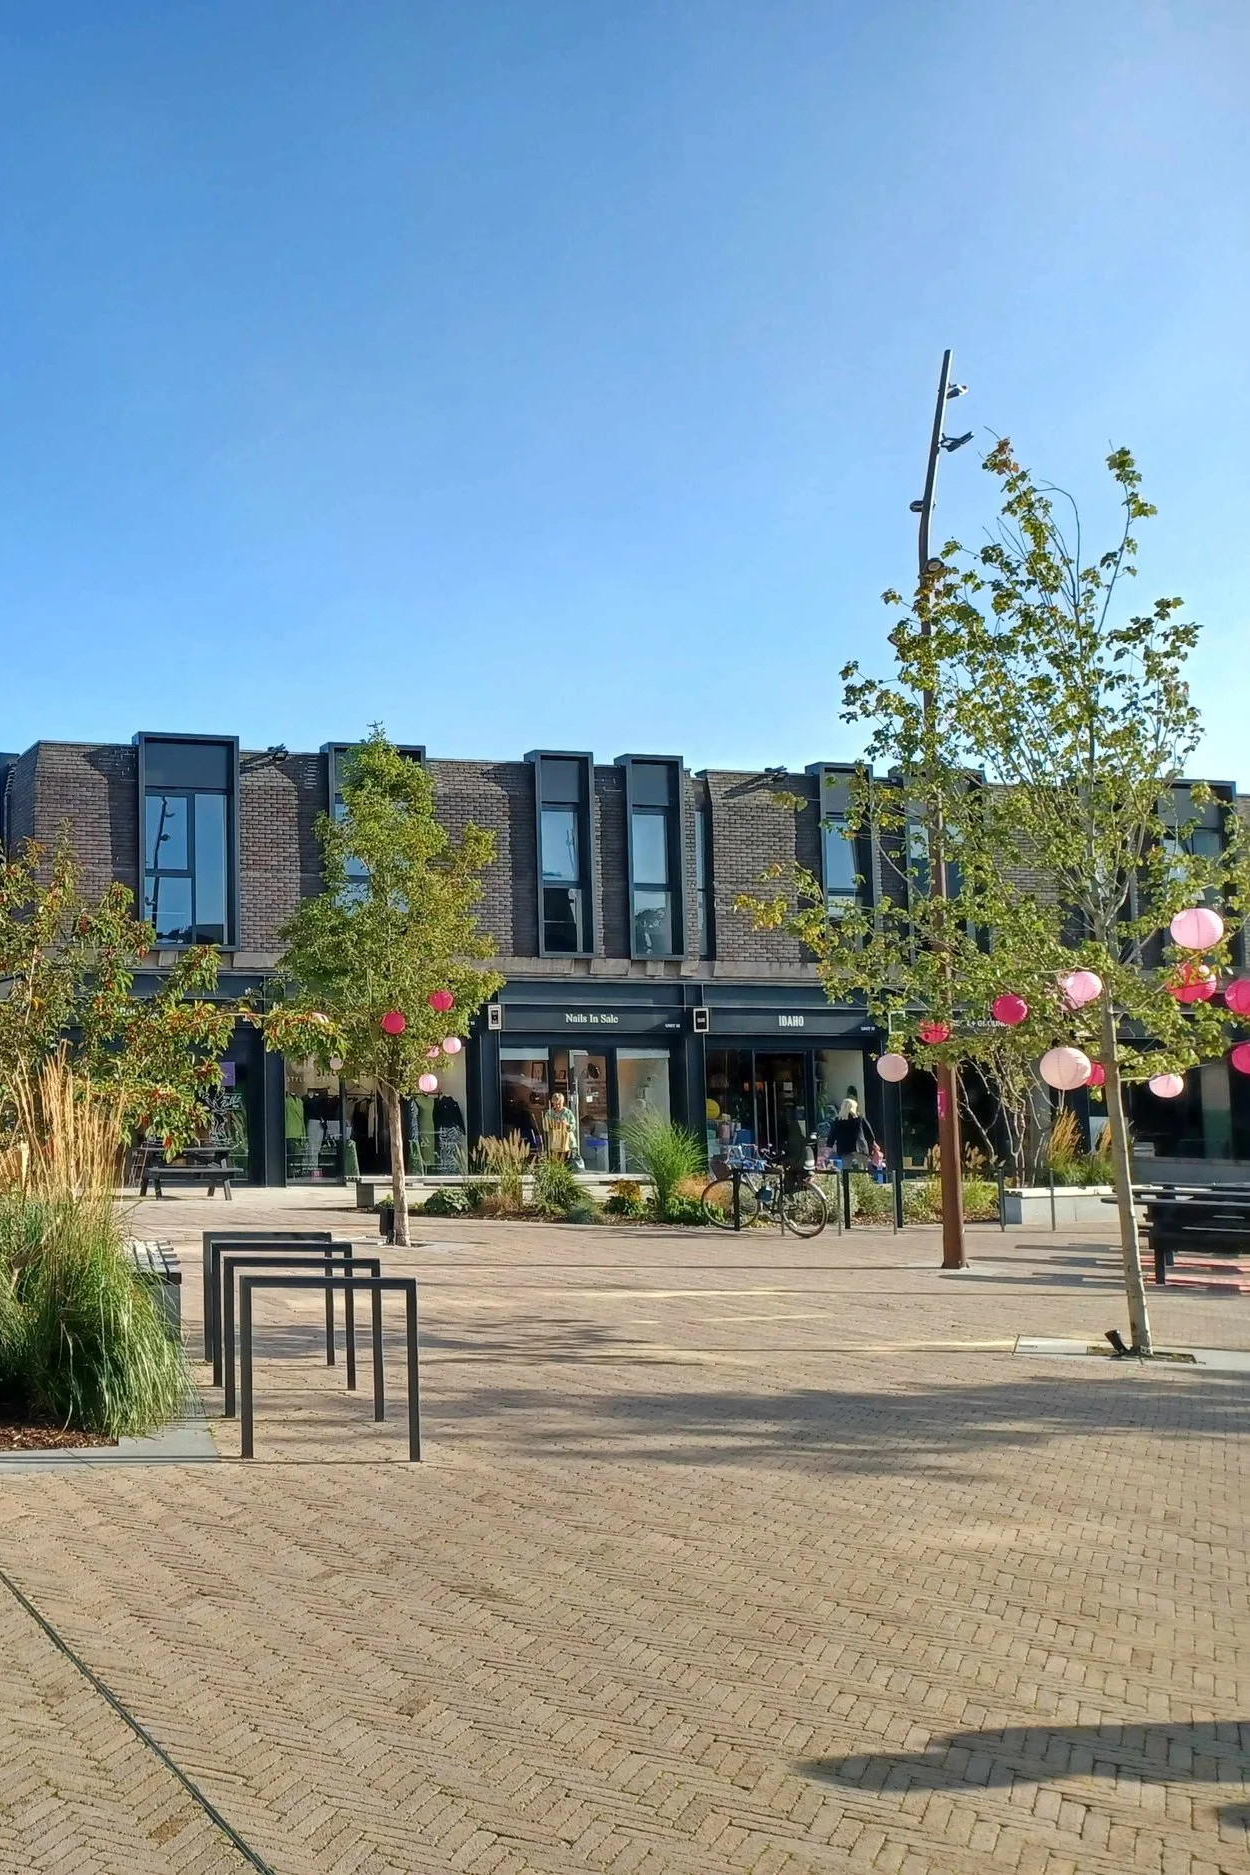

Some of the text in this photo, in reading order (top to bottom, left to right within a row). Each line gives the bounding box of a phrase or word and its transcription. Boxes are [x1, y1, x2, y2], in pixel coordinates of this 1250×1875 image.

[565, 1013, 619, 1024] Nails In Sale
[778, 1015, 804, 1027] IDAHO
